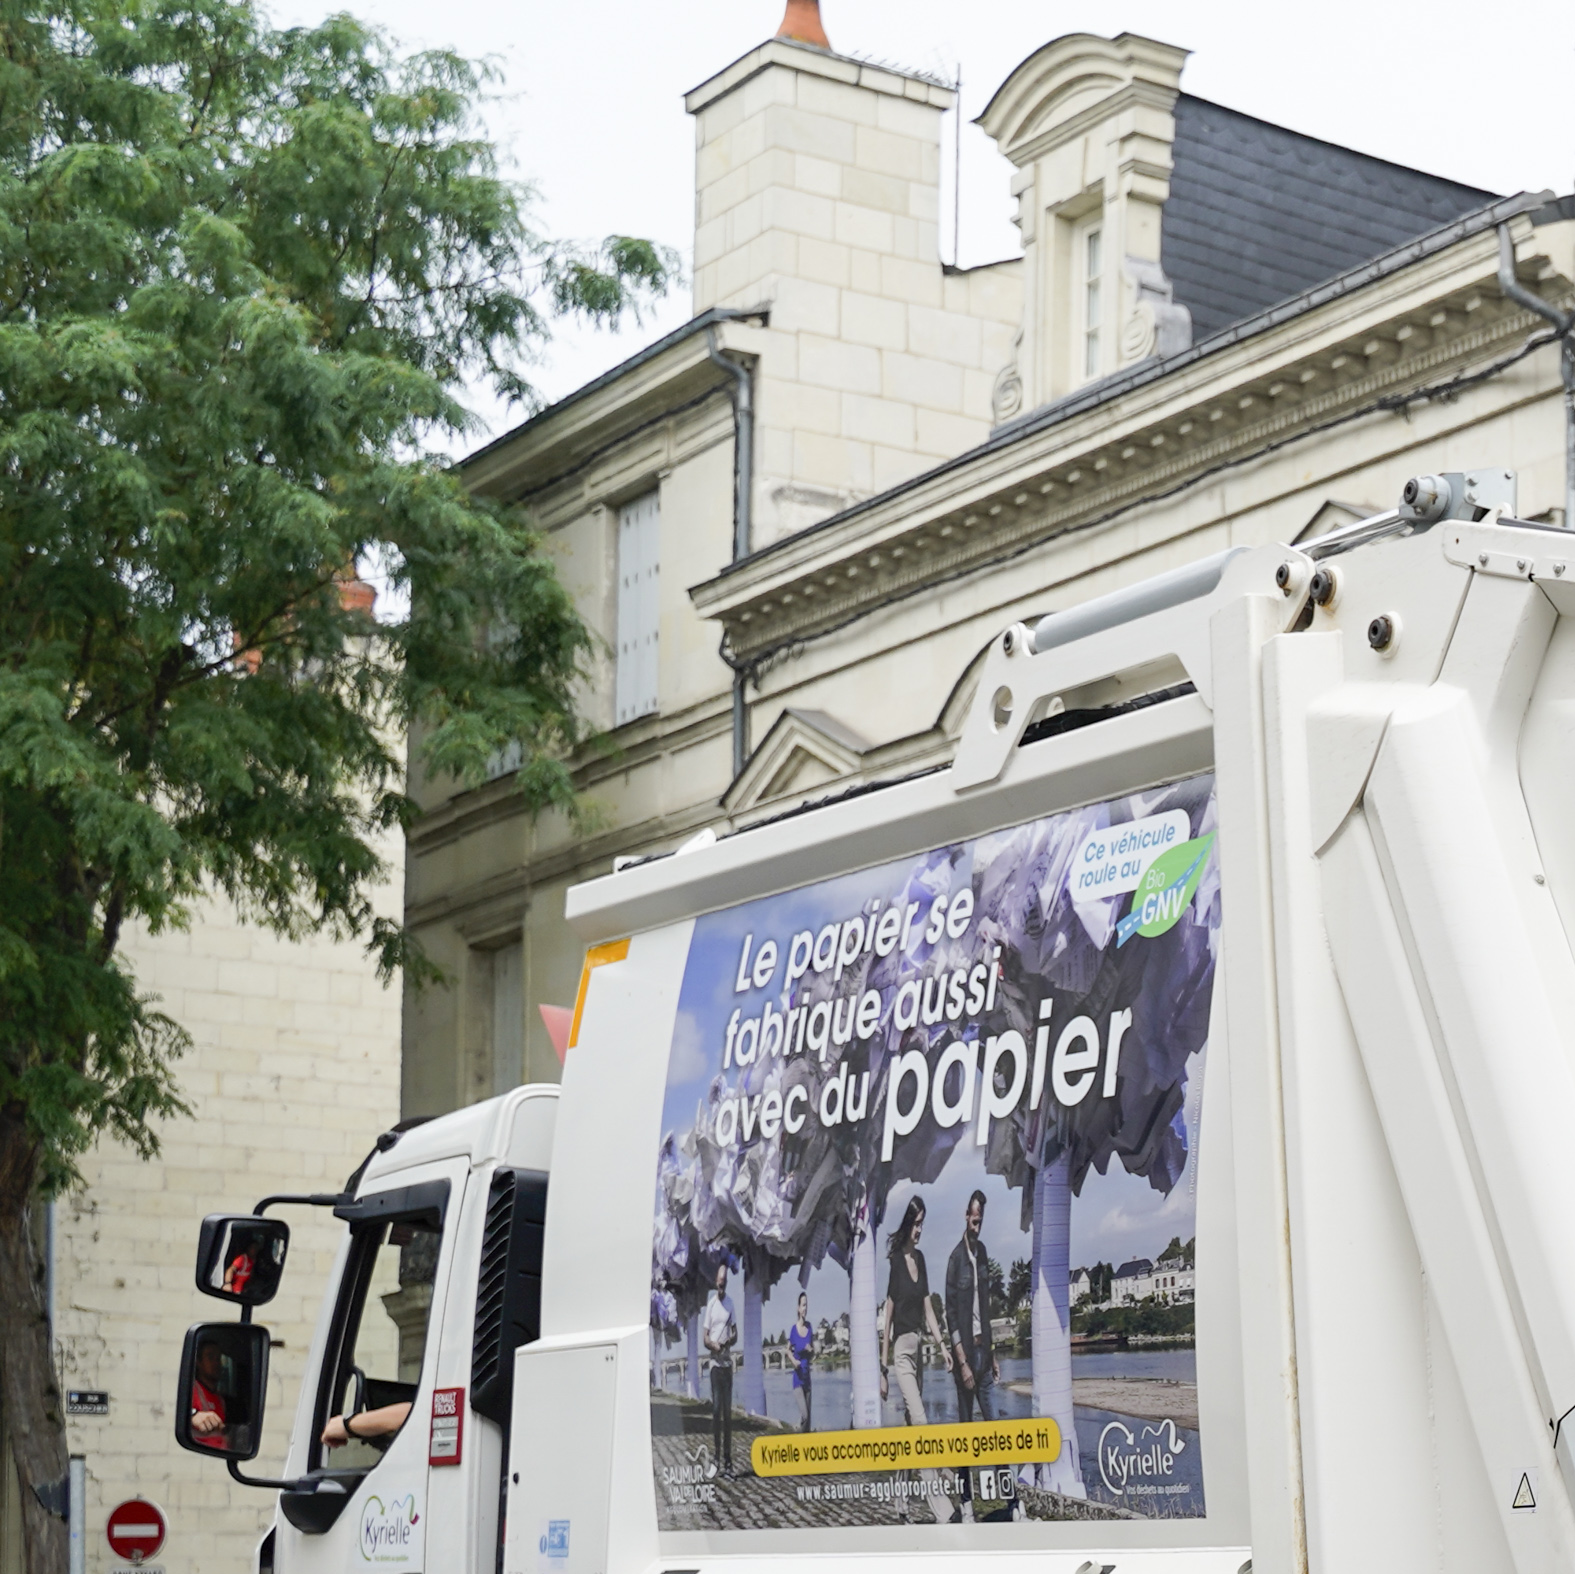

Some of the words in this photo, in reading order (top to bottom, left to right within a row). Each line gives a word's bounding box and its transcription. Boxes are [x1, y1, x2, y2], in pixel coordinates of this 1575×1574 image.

[1084, 842, 1106, 863] Ce
[1110, 822, 1176, 857] véhicule
[1078, 862, 1117, 889] roule
[1120, 859, 1142, 879] au
[1145, 868, 1166, 890] Bio
[1141, 885, 1187, 925] GNV
[734, 934, 778, 993] Le
[783, 898, 921, 991] papier
[924, 887, 974, 945] se
[722, 986, 882, 1070] fabrique
[892, 945, 1002, 1031] aussi
[714, 1082, 808, 1148] avec
[819, 1060, 870, 1128] du
[880, 998, 1133, 1163] papier
[761, 1444, 801, 1468] Kyrielle
[802, 1447, 829, 1462] vous
[832, 1441, 912, 1464] accompagne
[915, 1435, 944, 1456] dans
[947, 1439, 969, 1453] vos
[972, 1432, 1013, 1457] gestes
[1016, 1429, 1033, 1450] de
[1036, 1428, 1049, 1450] tri
[1107, 1444, 1174, 1486] Kyrielle
[663, 1464, 705, 1485] SAUMUR
[670, 1485, 686, 1503] VAL
[692, 1484, 716, 1503] LOIRE
[797, 1473, 966, 1502] www.saumur-aggloproprete.fr
[365, 1516, 411, 1554] Kyrielle
